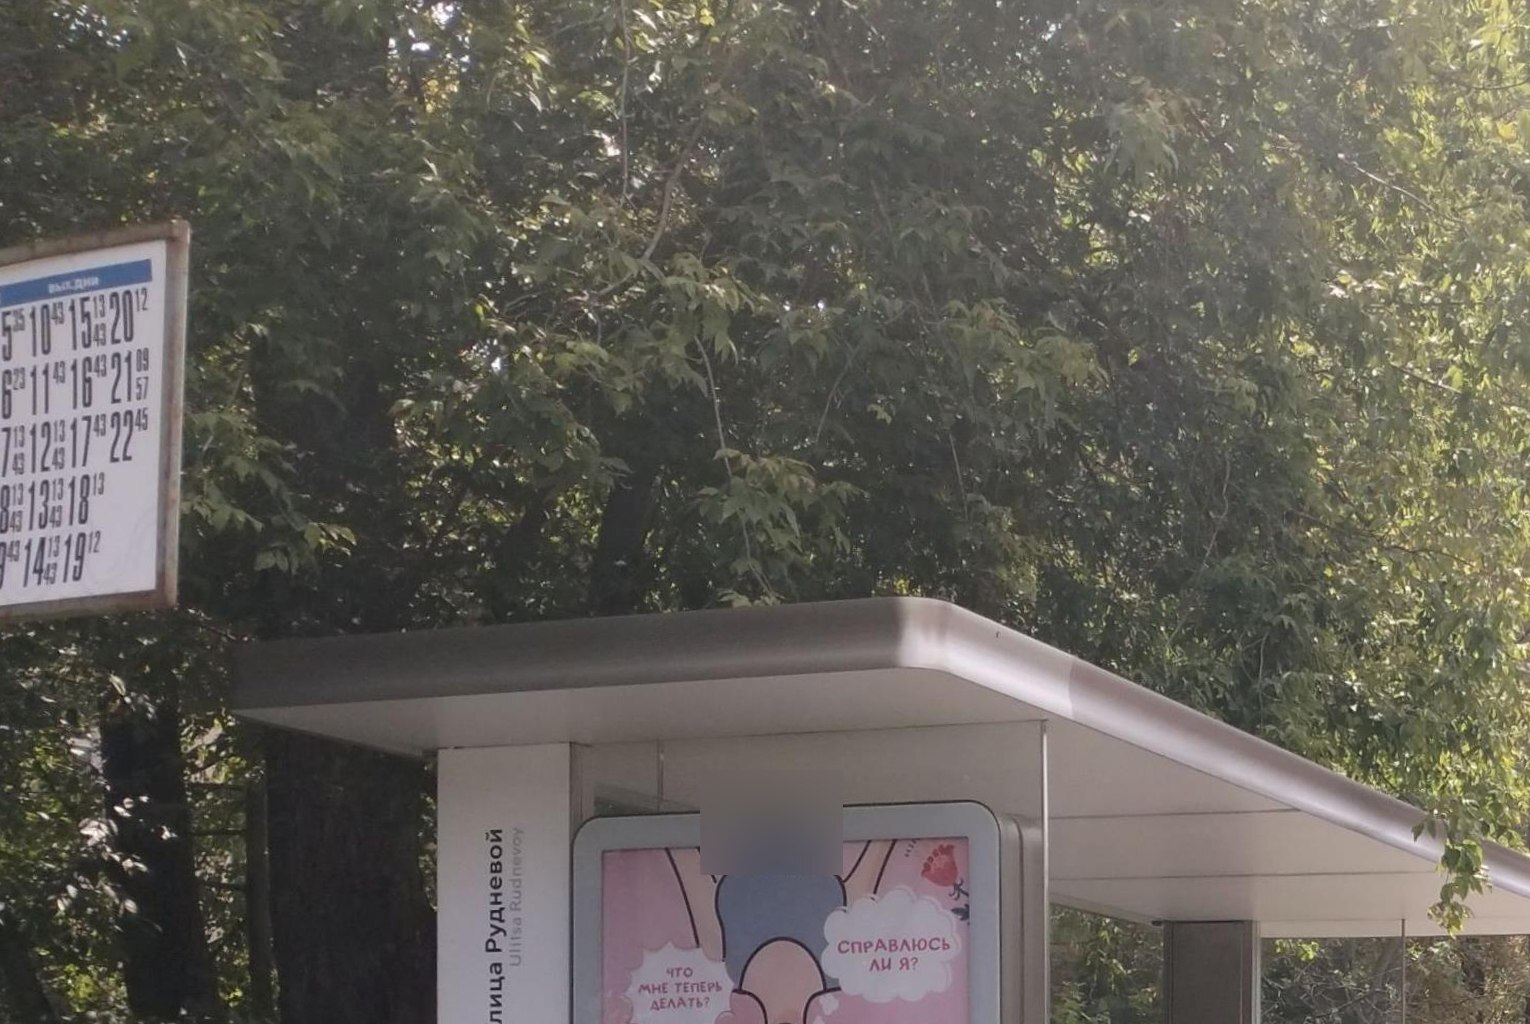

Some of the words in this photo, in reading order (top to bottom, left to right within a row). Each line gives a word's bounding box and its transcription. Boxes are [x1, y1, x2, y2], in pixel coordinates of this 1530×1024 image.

[30, 305, 51, 357] 10
[69, 298, 92, 351] 15
[109, 290, 134, 344] 20
[30, 364, 49, 415] 11
[70, 355, 93, 410] 16
[111, 350, 132, 404] 21
[30, 421, 51, 473] 12
[70, 415, 92, 468] 17
[110, 410, 134, 463] 22
[28, 480, 50, 531] 13
[68, 474, 91, 526] 18
[23, 537, 46, 588] 14
[63, 532, 87, 583] 19
[485, 828, 507, 953] Рудневой
[509, 827, 524, 911] Rudnevoy
[509, 916, 522, 967] Ulitsa
[837, 937, 950, 954] СПРАВЛЮСЬ
[869, 957, 892, 972] ЛИ
[899, 956, 919, 971] Я?
[638, 982, 669, 994] МНЕ
[674, 981, 722, 993] ТЕПЕРЬ
[666, 967, 693, 978] ЧТО
[650, 997, 710, 1011] ДЕЛАТЬ?
